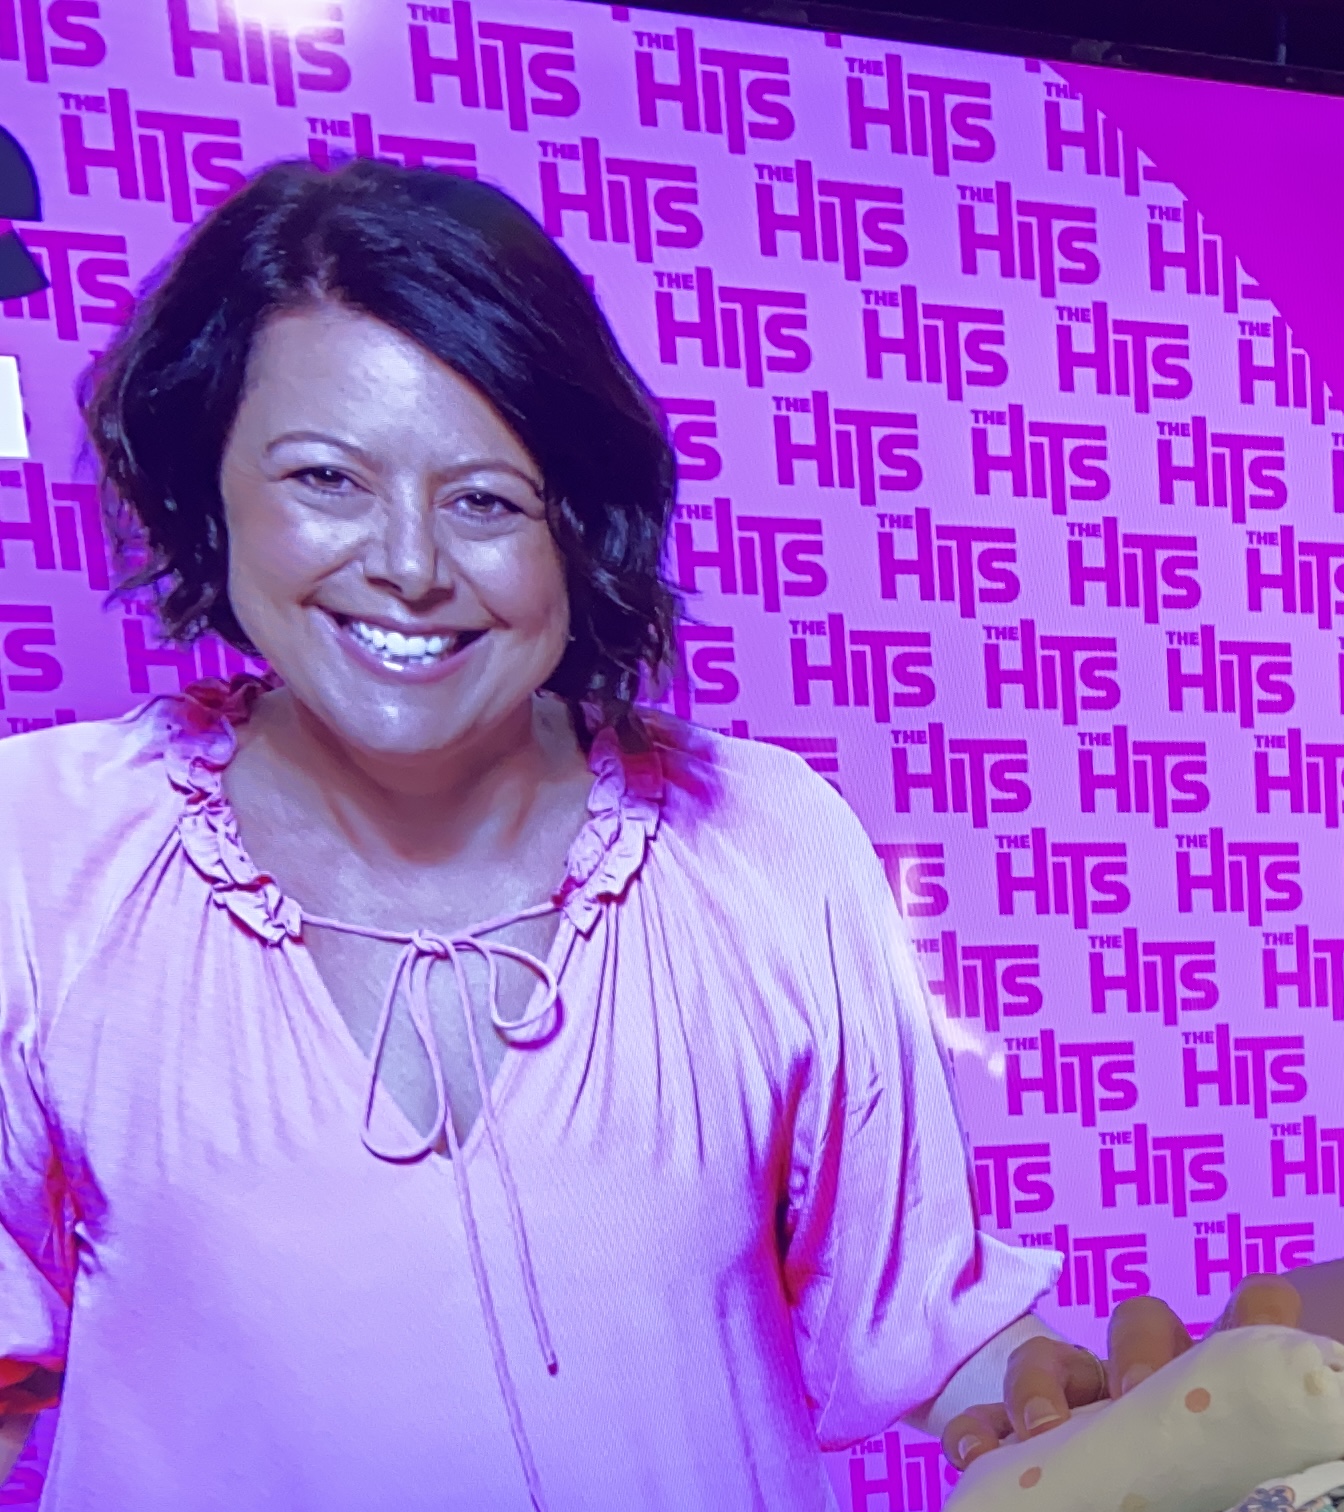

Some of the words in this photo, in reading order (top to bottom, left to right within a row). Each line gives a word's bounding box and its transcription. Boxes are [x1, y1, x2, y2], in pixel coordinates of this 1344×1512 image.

[407, 3, 451, 24] THE
[637, 31, 678, 53] THE
[845, 57, 884, 76] THE
[59, 93, 107, 113] THE
[538, 141, 581, 160] THE
[753, 164, 792, 183] THE
[957, 185, 995, 203] THE
[654, 271, 695, 290] THE
[861, 289, 899, 307] THE
[1056, 306, 1091, 323] THE
[772, 396, 811, 413] THE
[971, 410, 1006, 425] THE
[1157, 421, 1190, 437] THE
[877, 514, 913, 529] THE
[1067, 523, 1102, 537] THE
[1247, 531, 1278, 545] THE
[789, 620, 827, 635] THE
[983, 626, 1019, 641] THE
[1166, 631, 1199, 645] THE
[891, 730, 927, 744] THE
[1078, 732, 1112, 746] THE
[1254, 735, 1286, 748] THE
[995, 835, 1030, 848] THE
[1176, 835, 1208, 848] THE
[1089, 935, 1122, 948] THE
[1263, 933, 1294, 945] THE
[1004, 1037, 1039, 1051] THE
[1182, 1031, 1214, 1044] THE
[1271, 1123, 1301, 1136] THE
[1099, 1131, 1132, 1145] THE
[1194, 1221, 1225, 1234] THE
